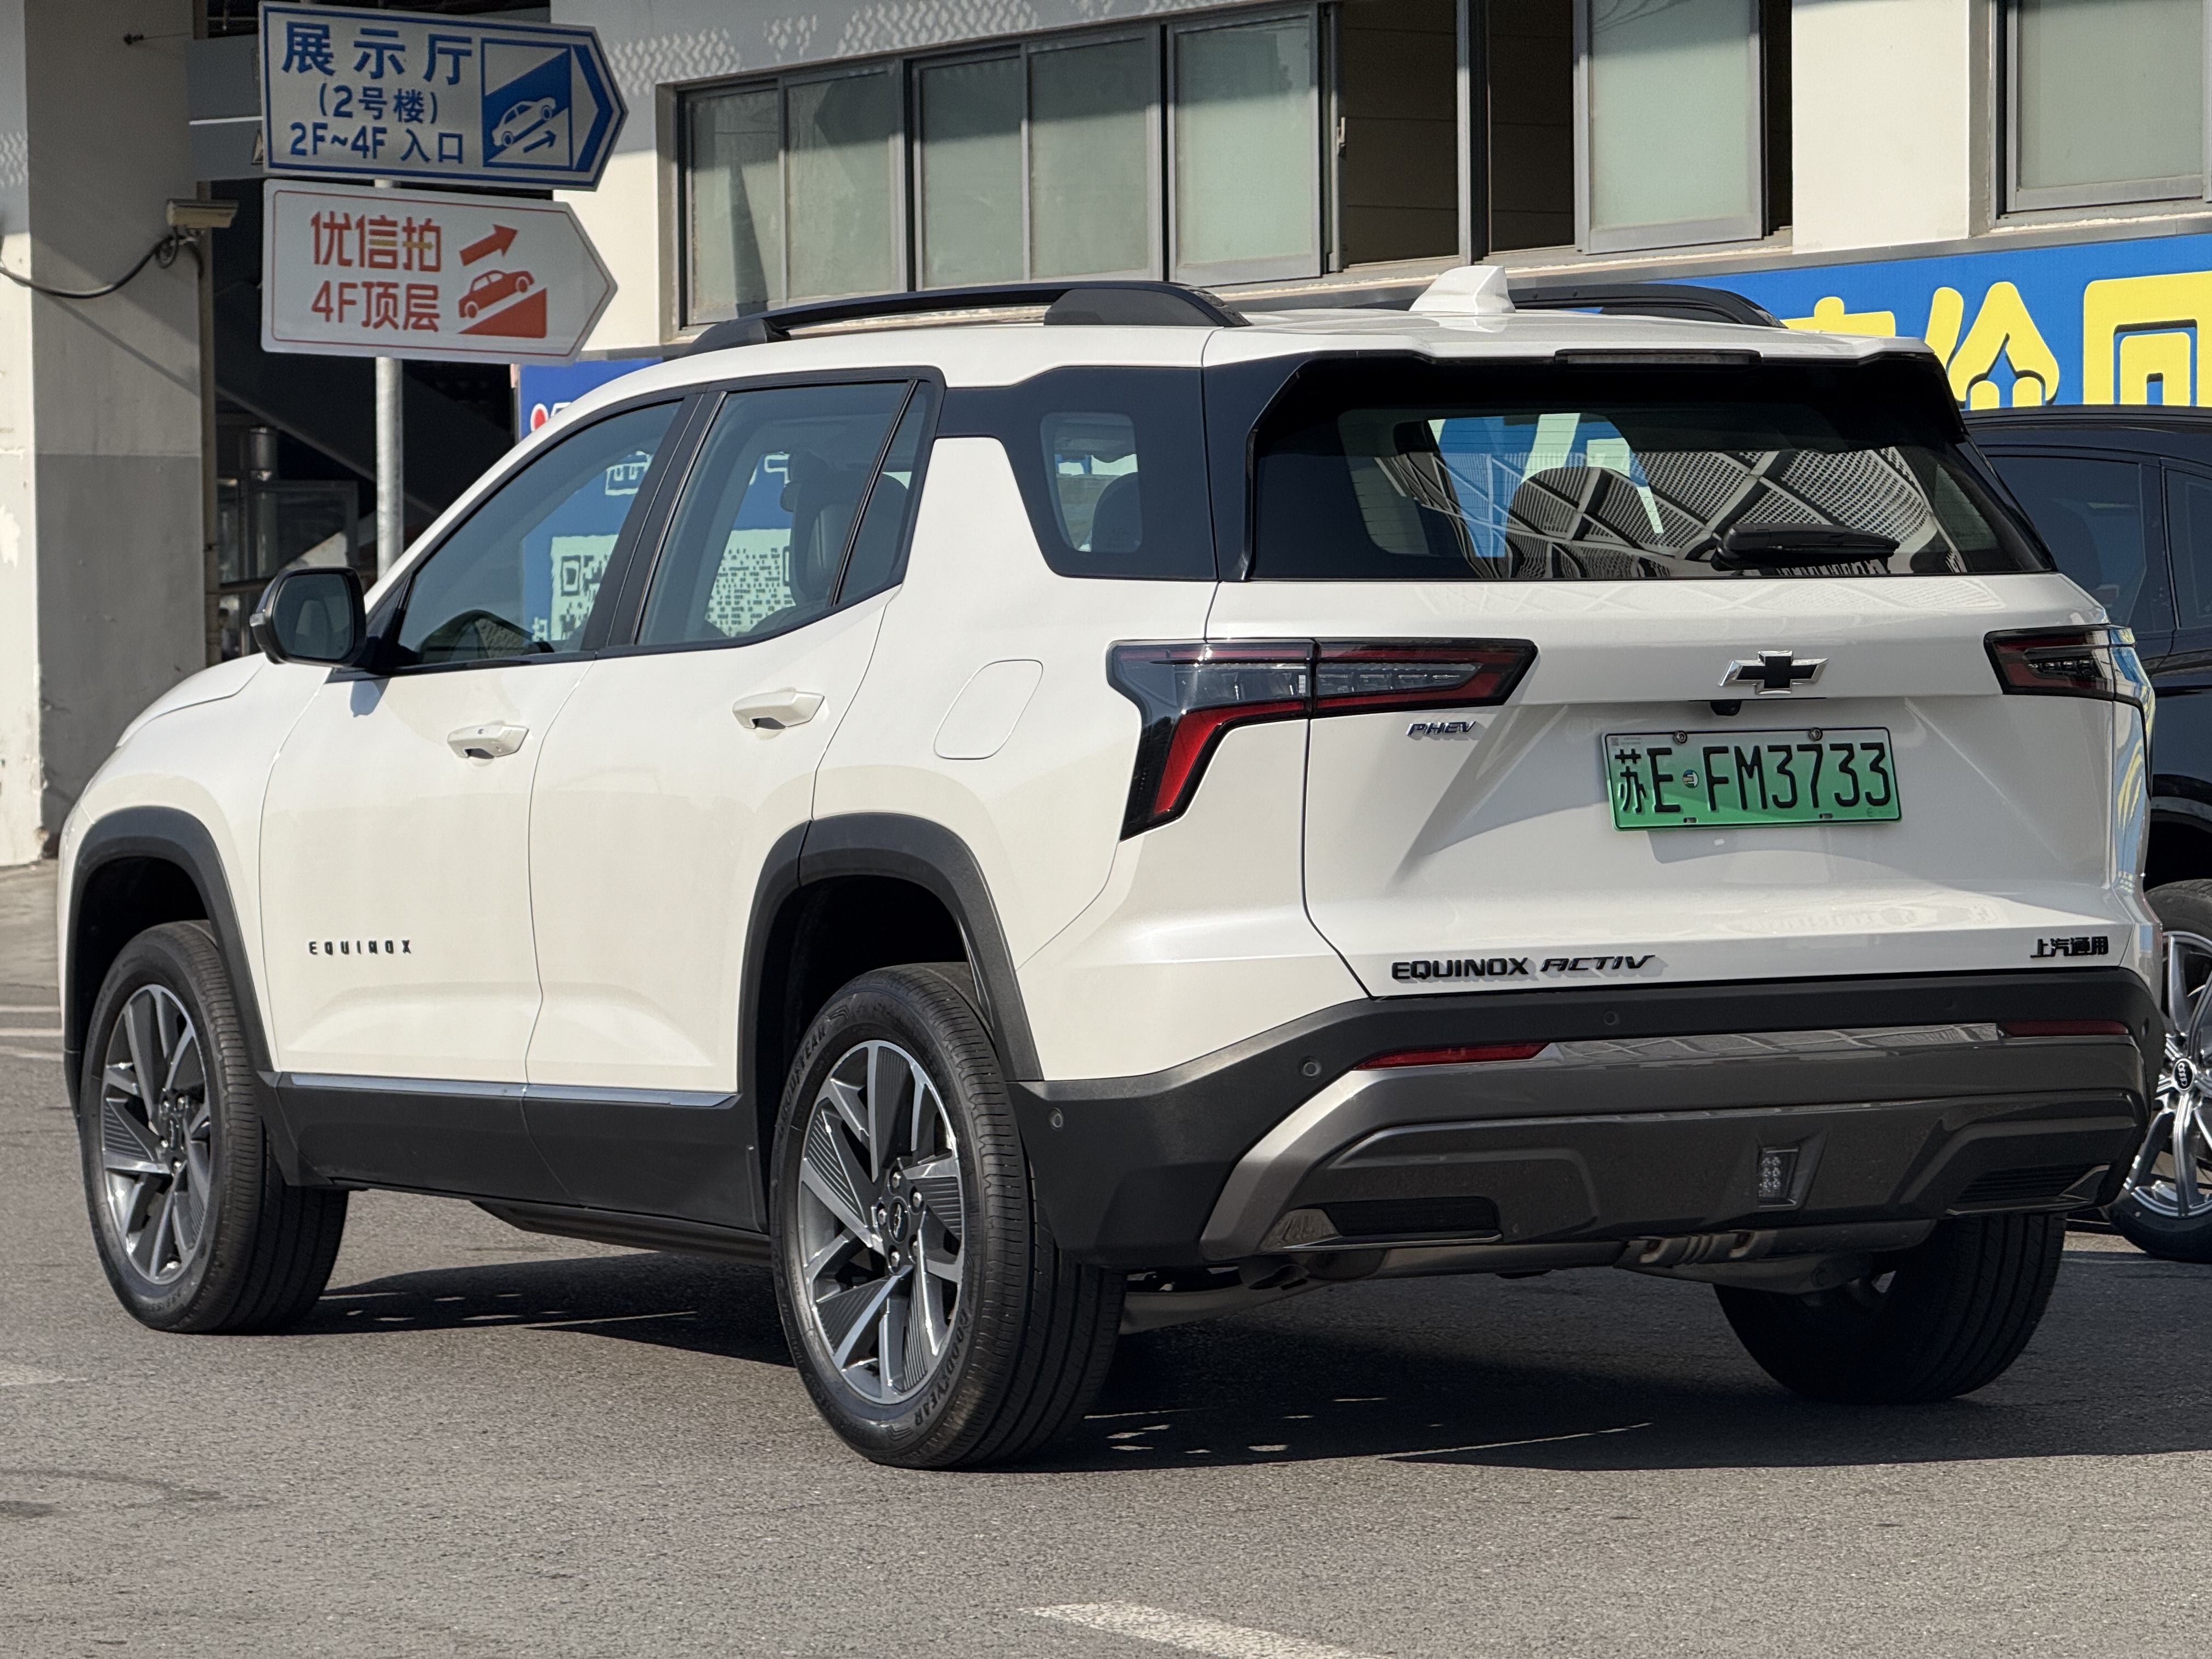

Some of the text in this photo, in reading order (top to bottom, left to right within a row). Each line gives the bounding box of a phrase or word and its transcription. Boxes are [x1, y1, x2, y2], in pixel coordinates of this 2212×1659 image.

[281, 21, 473, 86] 展示厅
[400, 132, 464, 164] 入口
[310, 211, 441, 272] 优信拍
[311, 280, 441, 332] 4F顶层
[1405, 720, 1477, 736] PHEV
[308, 939, 412, 956] EQUINOX
[2030, 936, 2109, 958] 上汽通用
[1391, 955, 1656, 980] EQUINOX ACTIV
